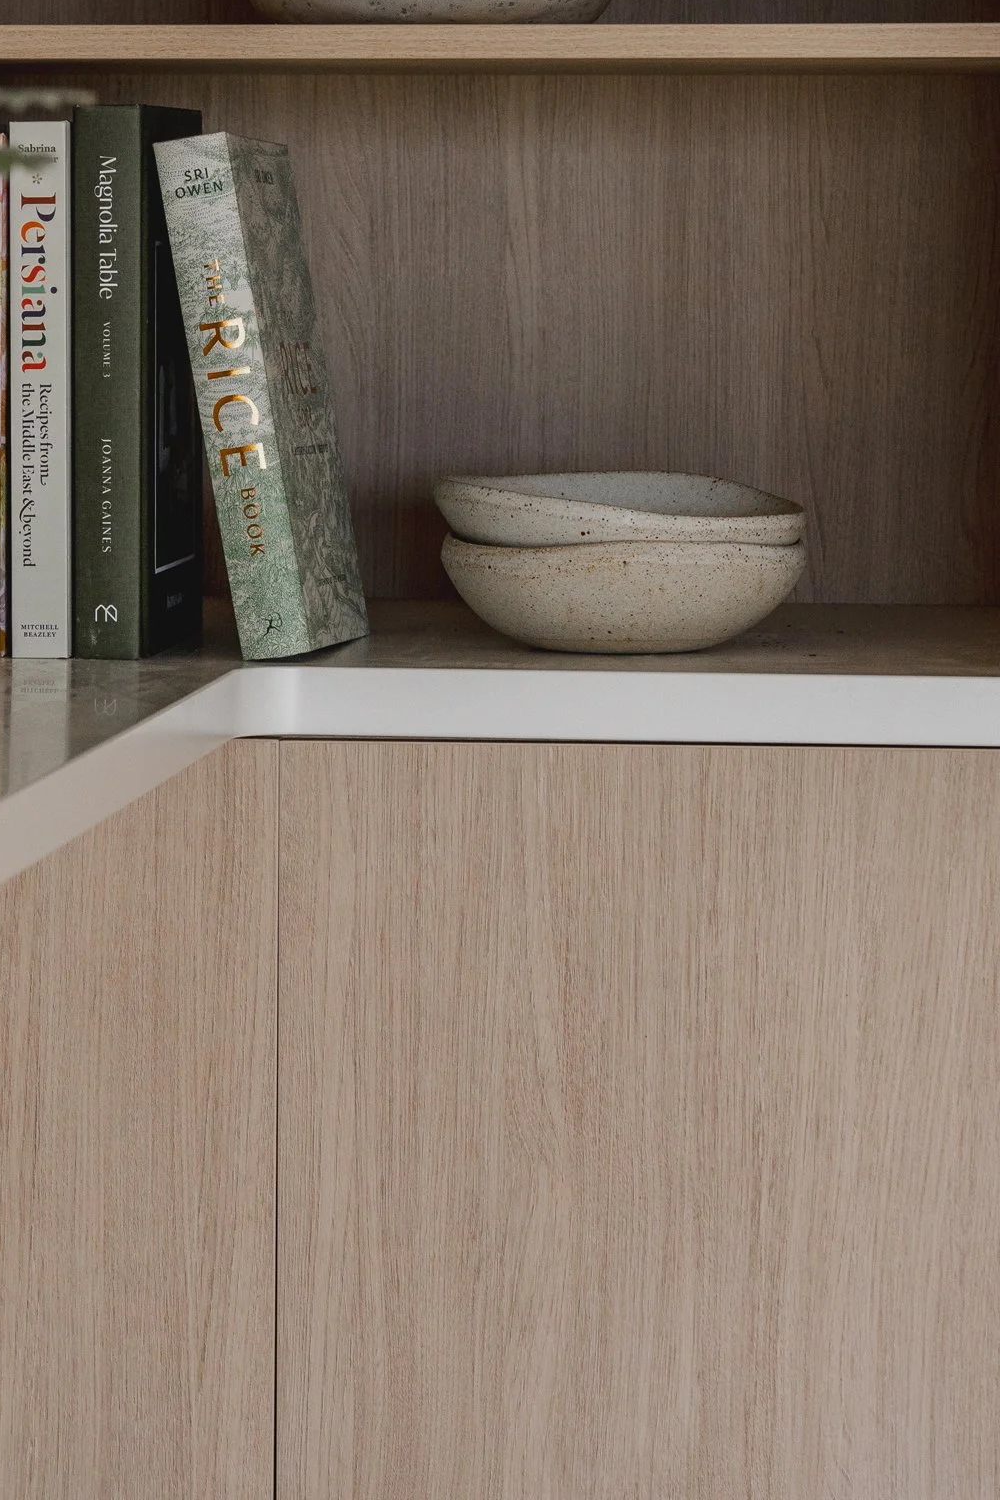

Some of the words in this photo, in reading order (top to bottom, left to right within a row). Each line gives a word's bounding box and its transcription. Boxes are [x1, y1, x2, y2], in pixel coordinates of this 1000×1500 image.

[17, 143, 57, 153] Sabrina
[175, 180, 224, 199] OWEN
[184, 167, 210, 182] SRI
[94, 155, 119, 245] Magnolia
[20, 191, 58, 373] Persiana
[98, 248, 119, 300] Table
[203, 259, 225, 307] THE
[102, 321, 111, 368] VOLUME
[21, 383, 35, 406] the
[36, 383, 53, 440] Recipes
[200, 316, 267, 477] RICE
[21, 409, 35, 462] Middle
[21, 464, 35, 495] East
[39, 442, 53, 486] from
[101, 438, 112, 495] JOANNA
[19, 497, 35, 522] &
[101, 500, 112, 553] GAINES
[240, 486, 266, 557] BOOK
[18, 514, 36, 568] beyond
[21, 623, 59, 631] MITCHELL
